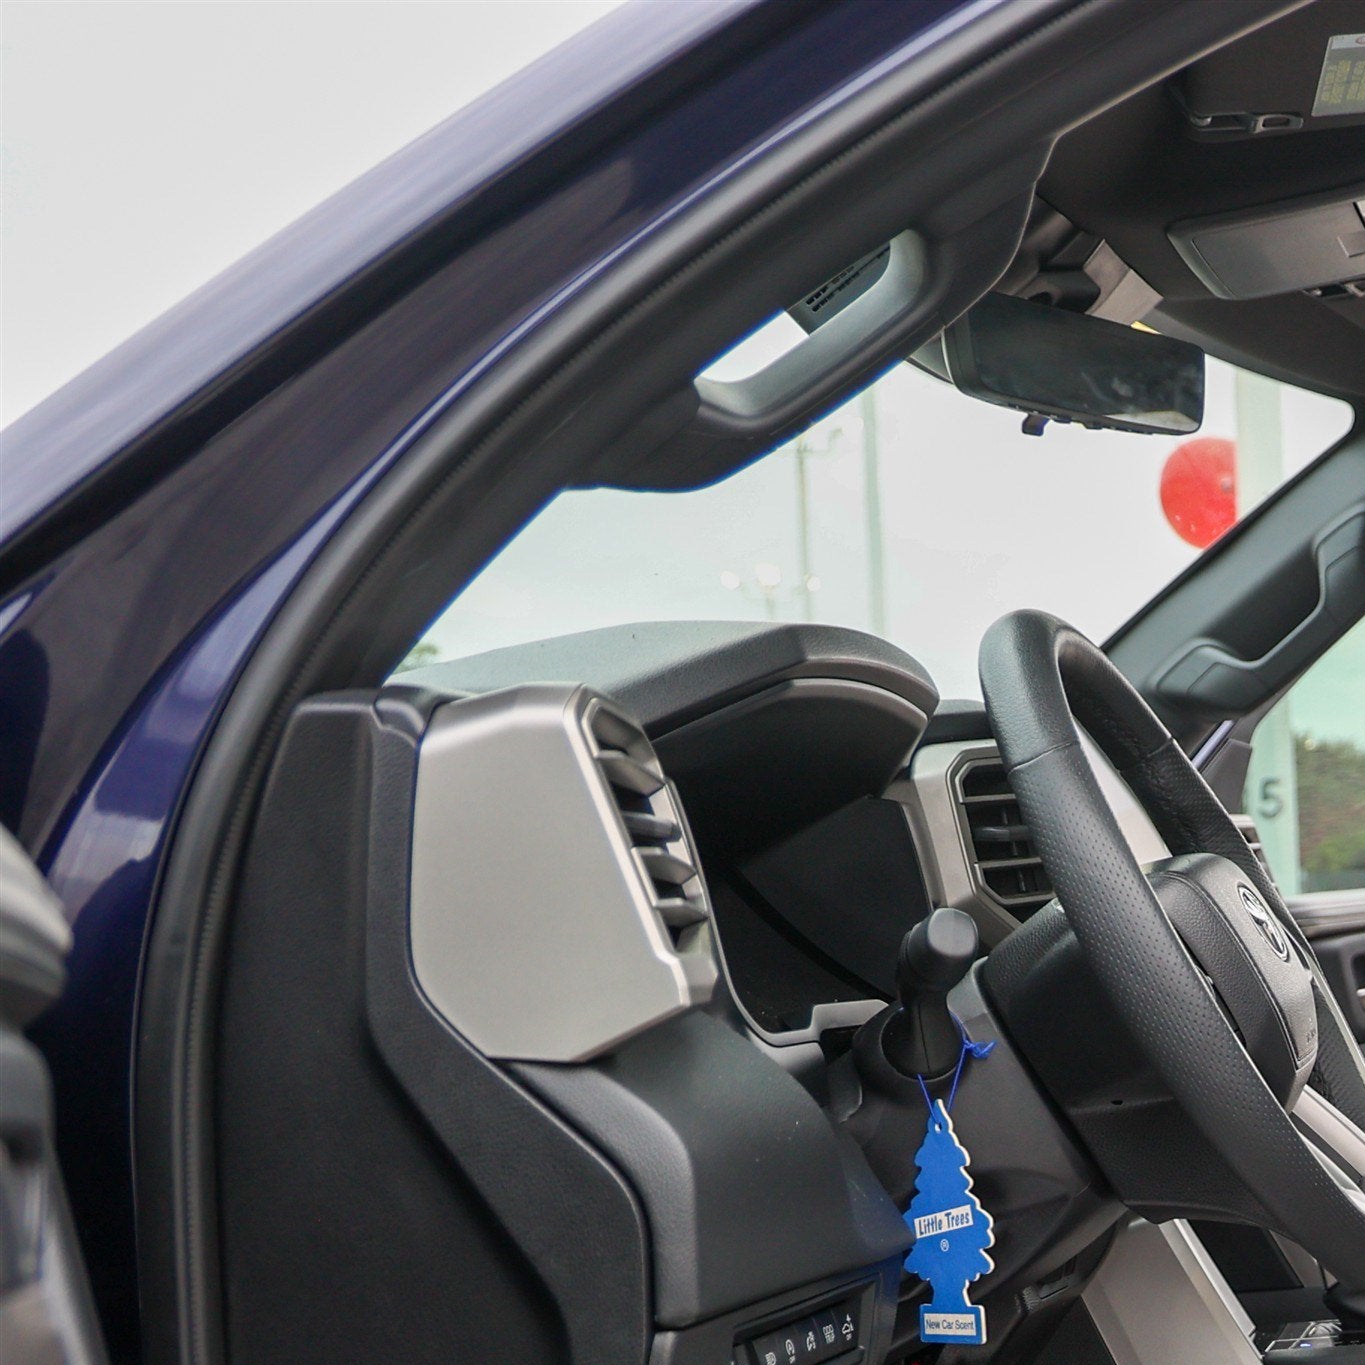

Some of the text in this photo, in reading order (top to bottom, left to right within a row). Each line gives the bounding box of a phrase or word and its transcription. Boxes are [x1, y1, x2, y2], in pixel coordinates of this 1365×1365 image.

[918, 1211, 970, 1236] Little Trees
[925, 1319, 975, 1330] New Car Scent
